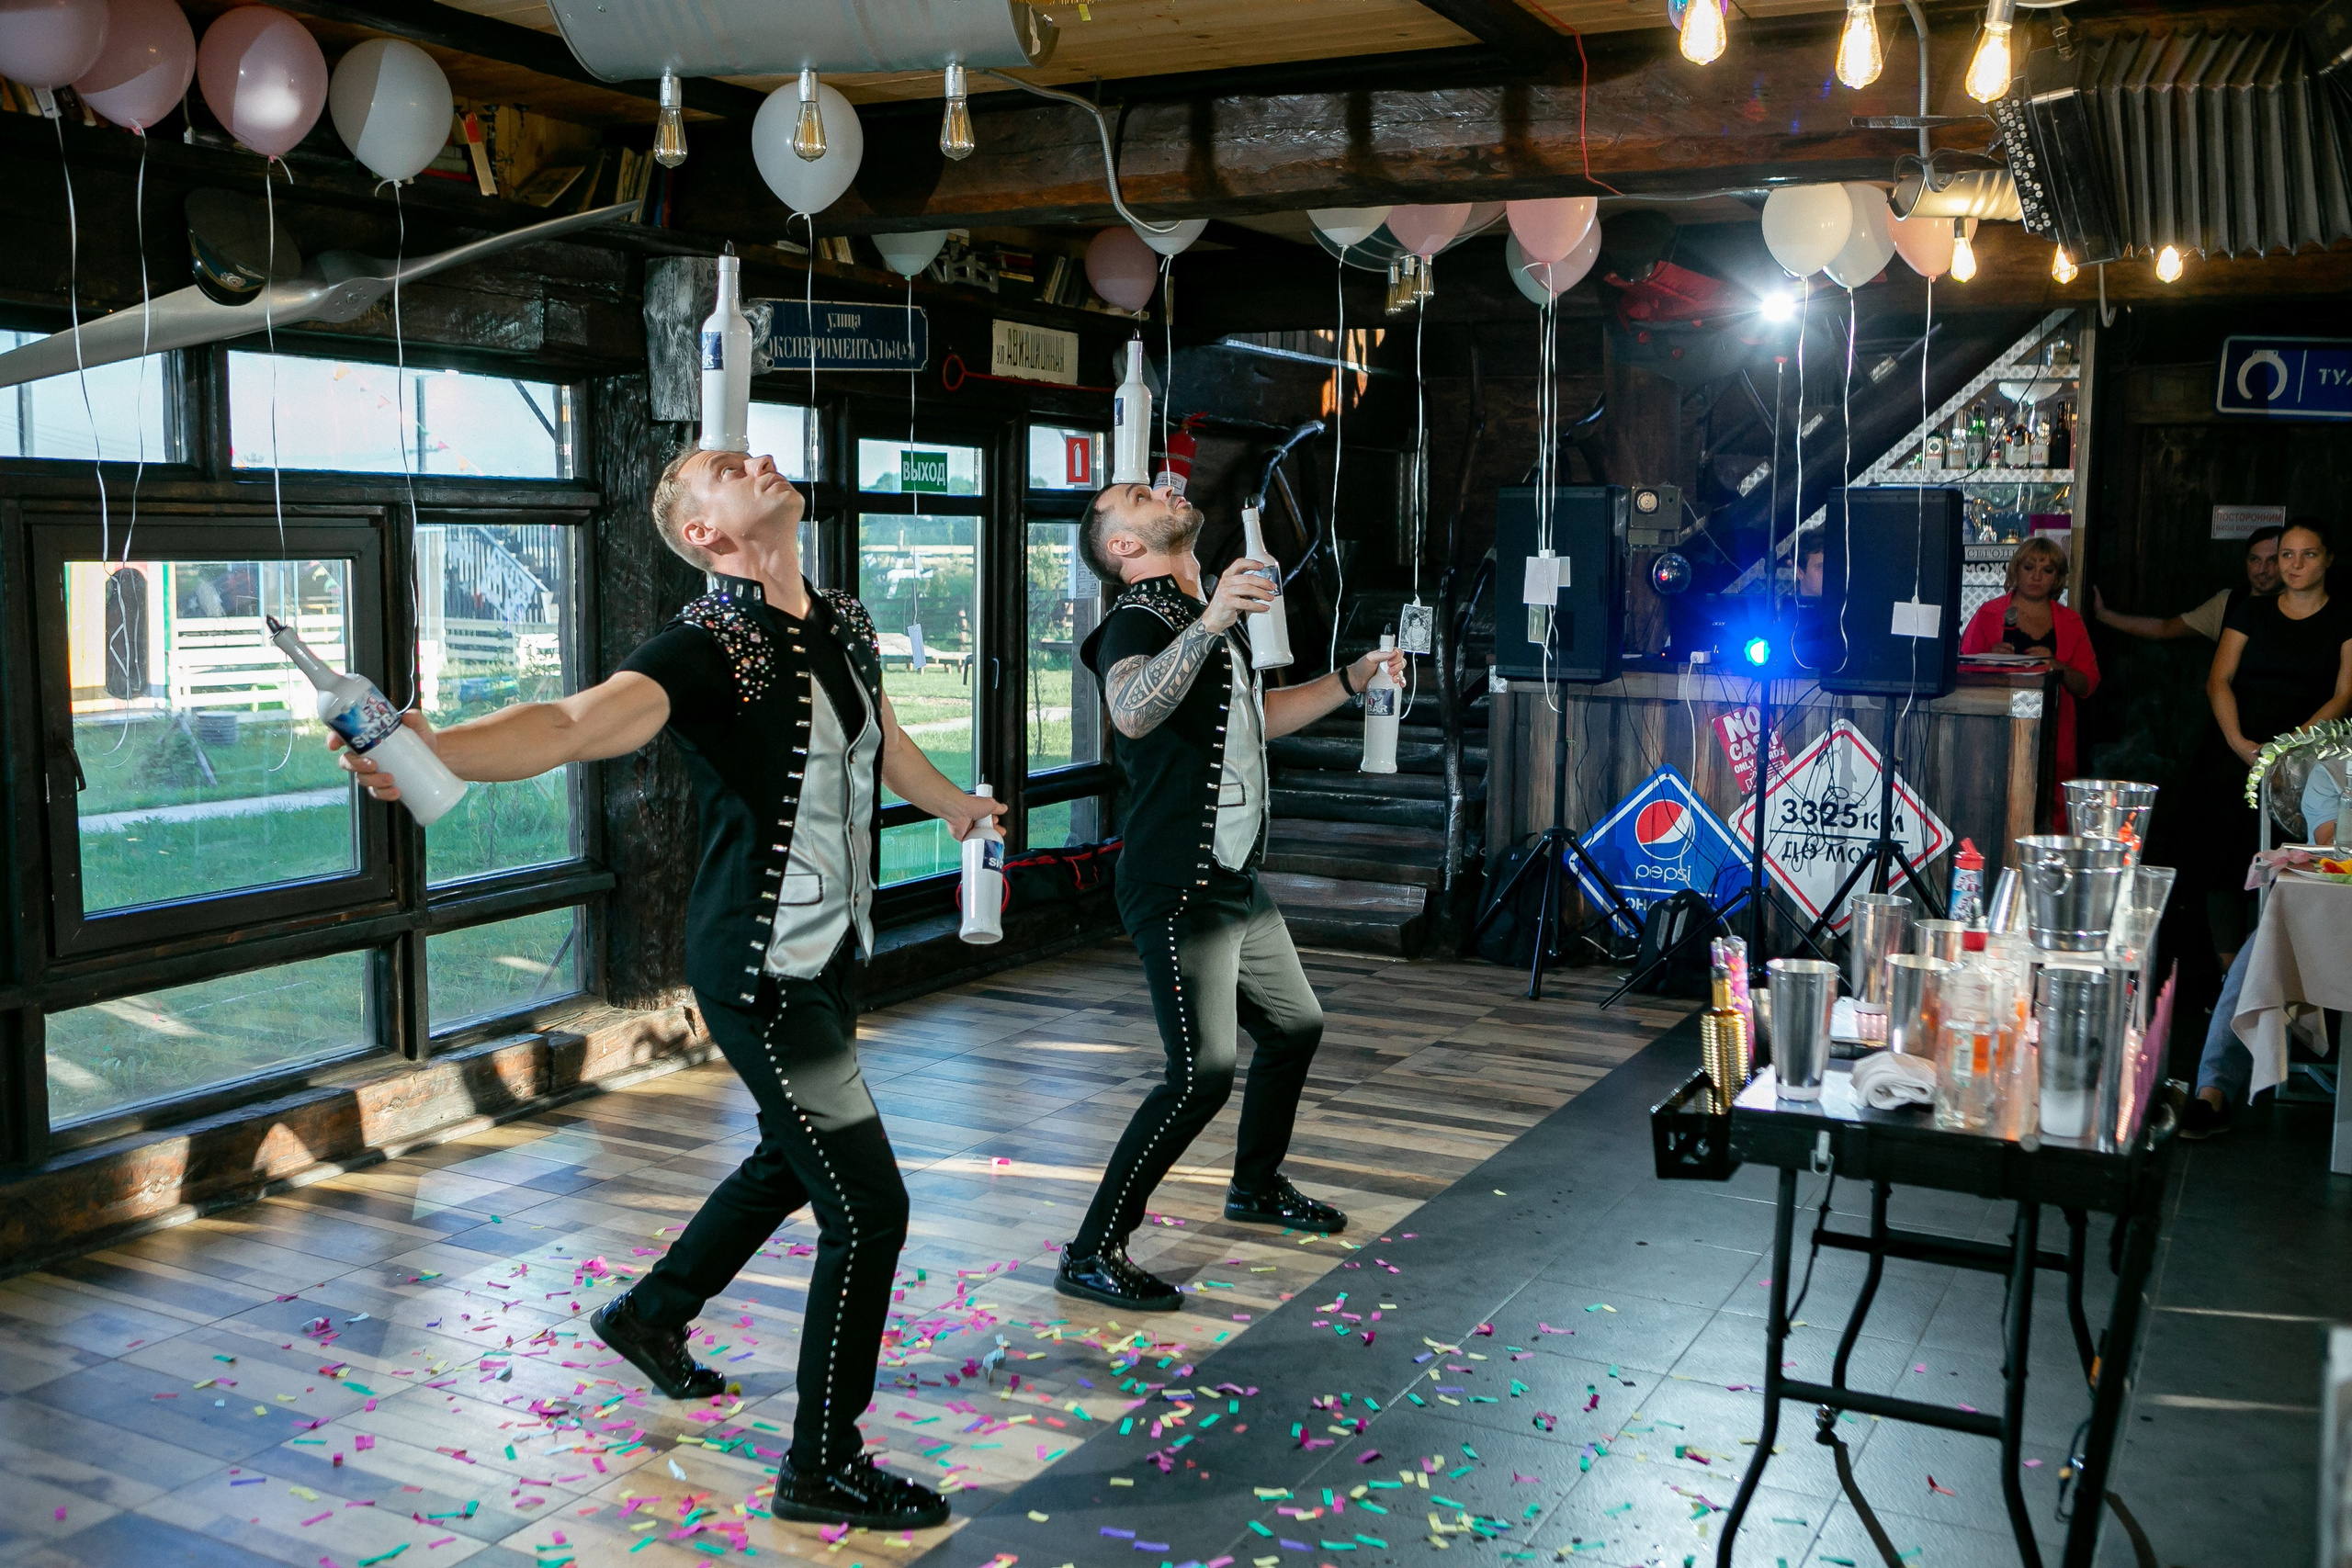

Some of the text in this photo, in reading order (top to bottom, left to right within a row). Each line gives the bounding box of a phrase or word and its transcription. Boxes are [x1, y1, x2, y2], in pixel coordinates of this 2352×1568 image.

[827, 312, 861, 333] улица
[902, 461, 947, 487] ВЫХОД
[2216, 512, 2282, 523] ПОСТОРОННИМ
[1723, 705, 1760, 743] NO
[1734, 758, 1755, 773] ONLY
[1781, 798, 1859, 829] 3325
[1635, 863, 1691, 884] pepsi
